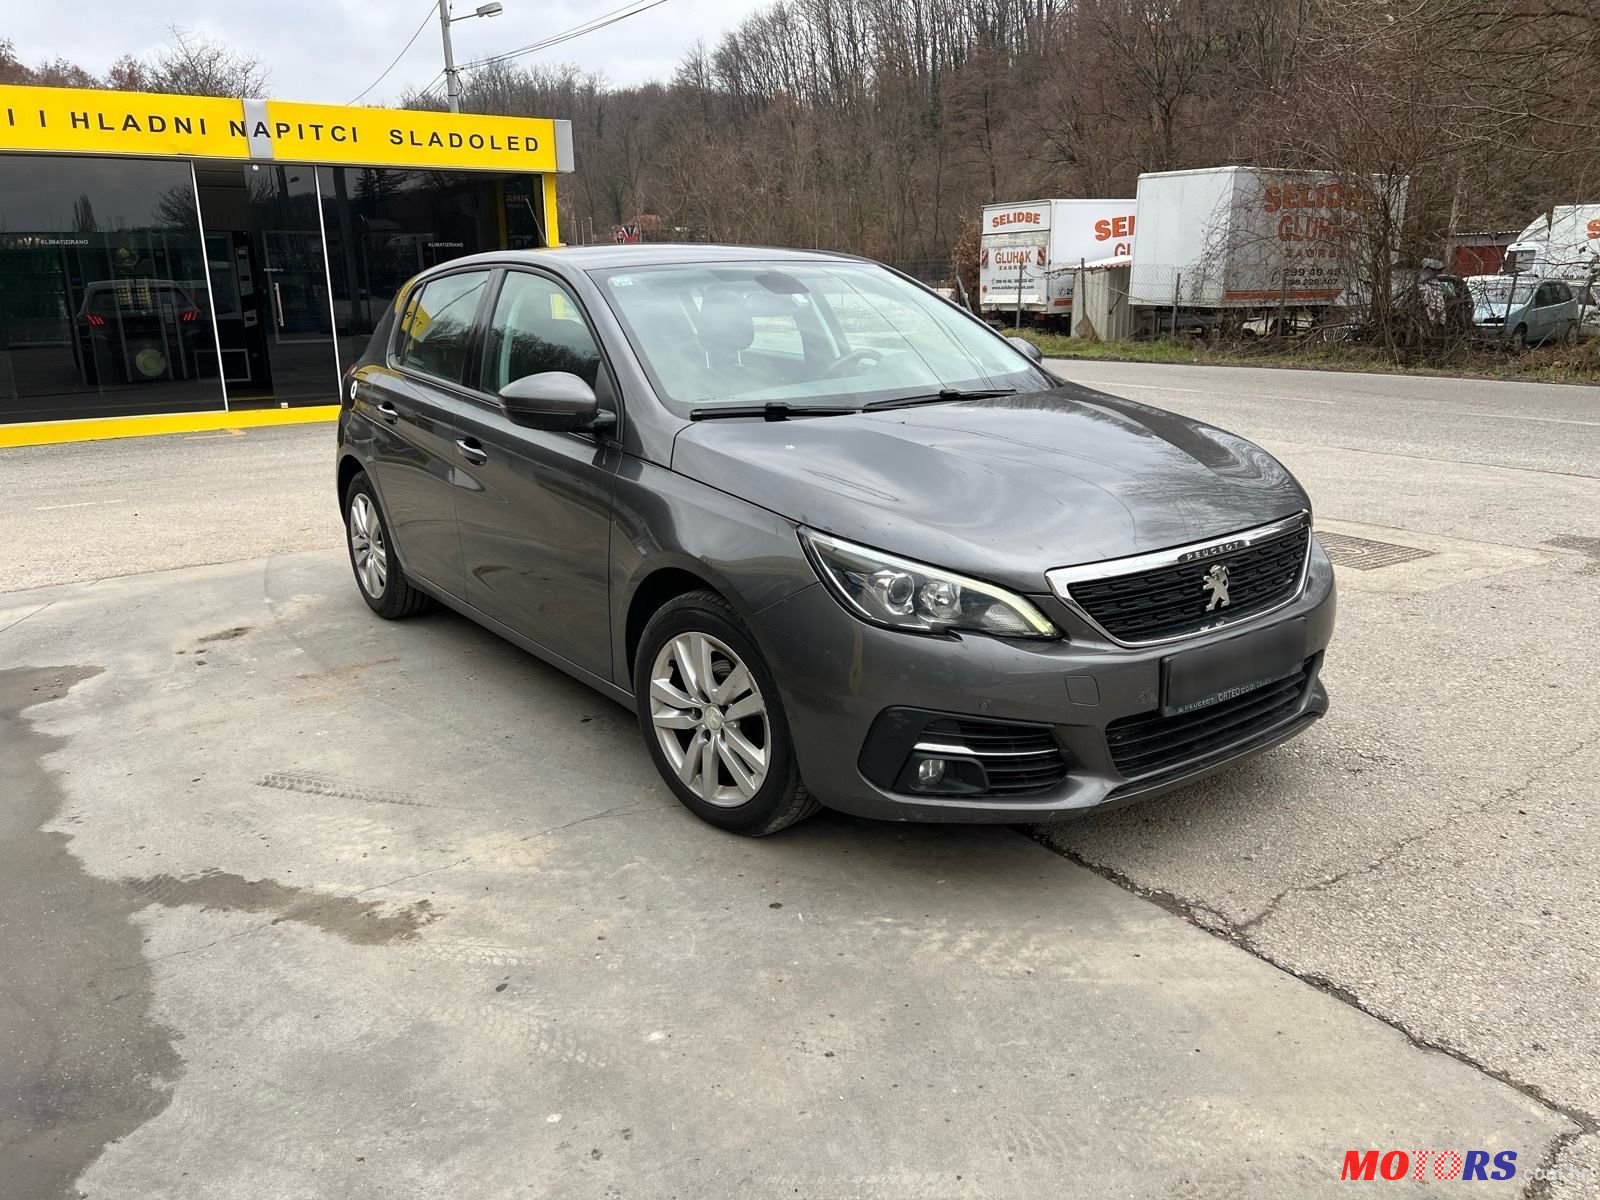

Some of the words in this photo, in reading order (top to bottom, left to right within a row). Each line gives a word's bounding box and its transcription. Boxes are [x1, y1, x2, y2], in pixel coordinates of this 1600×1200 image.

[70, 111, 207, 135] HLADNI
[229, 119, 358, 143] NAPITCI
[389, 128, 540, 152] SLADOLED
[1264, 183, 1374, 213] SELID
[992, 211, 1041, 229] SELIDBE
[40, 238, 89, 246] KLIMATIZIRANO
[995, 250, 1032, 265] GLUHAK
[1186, 541, 1241, 561] PEUGEOT
